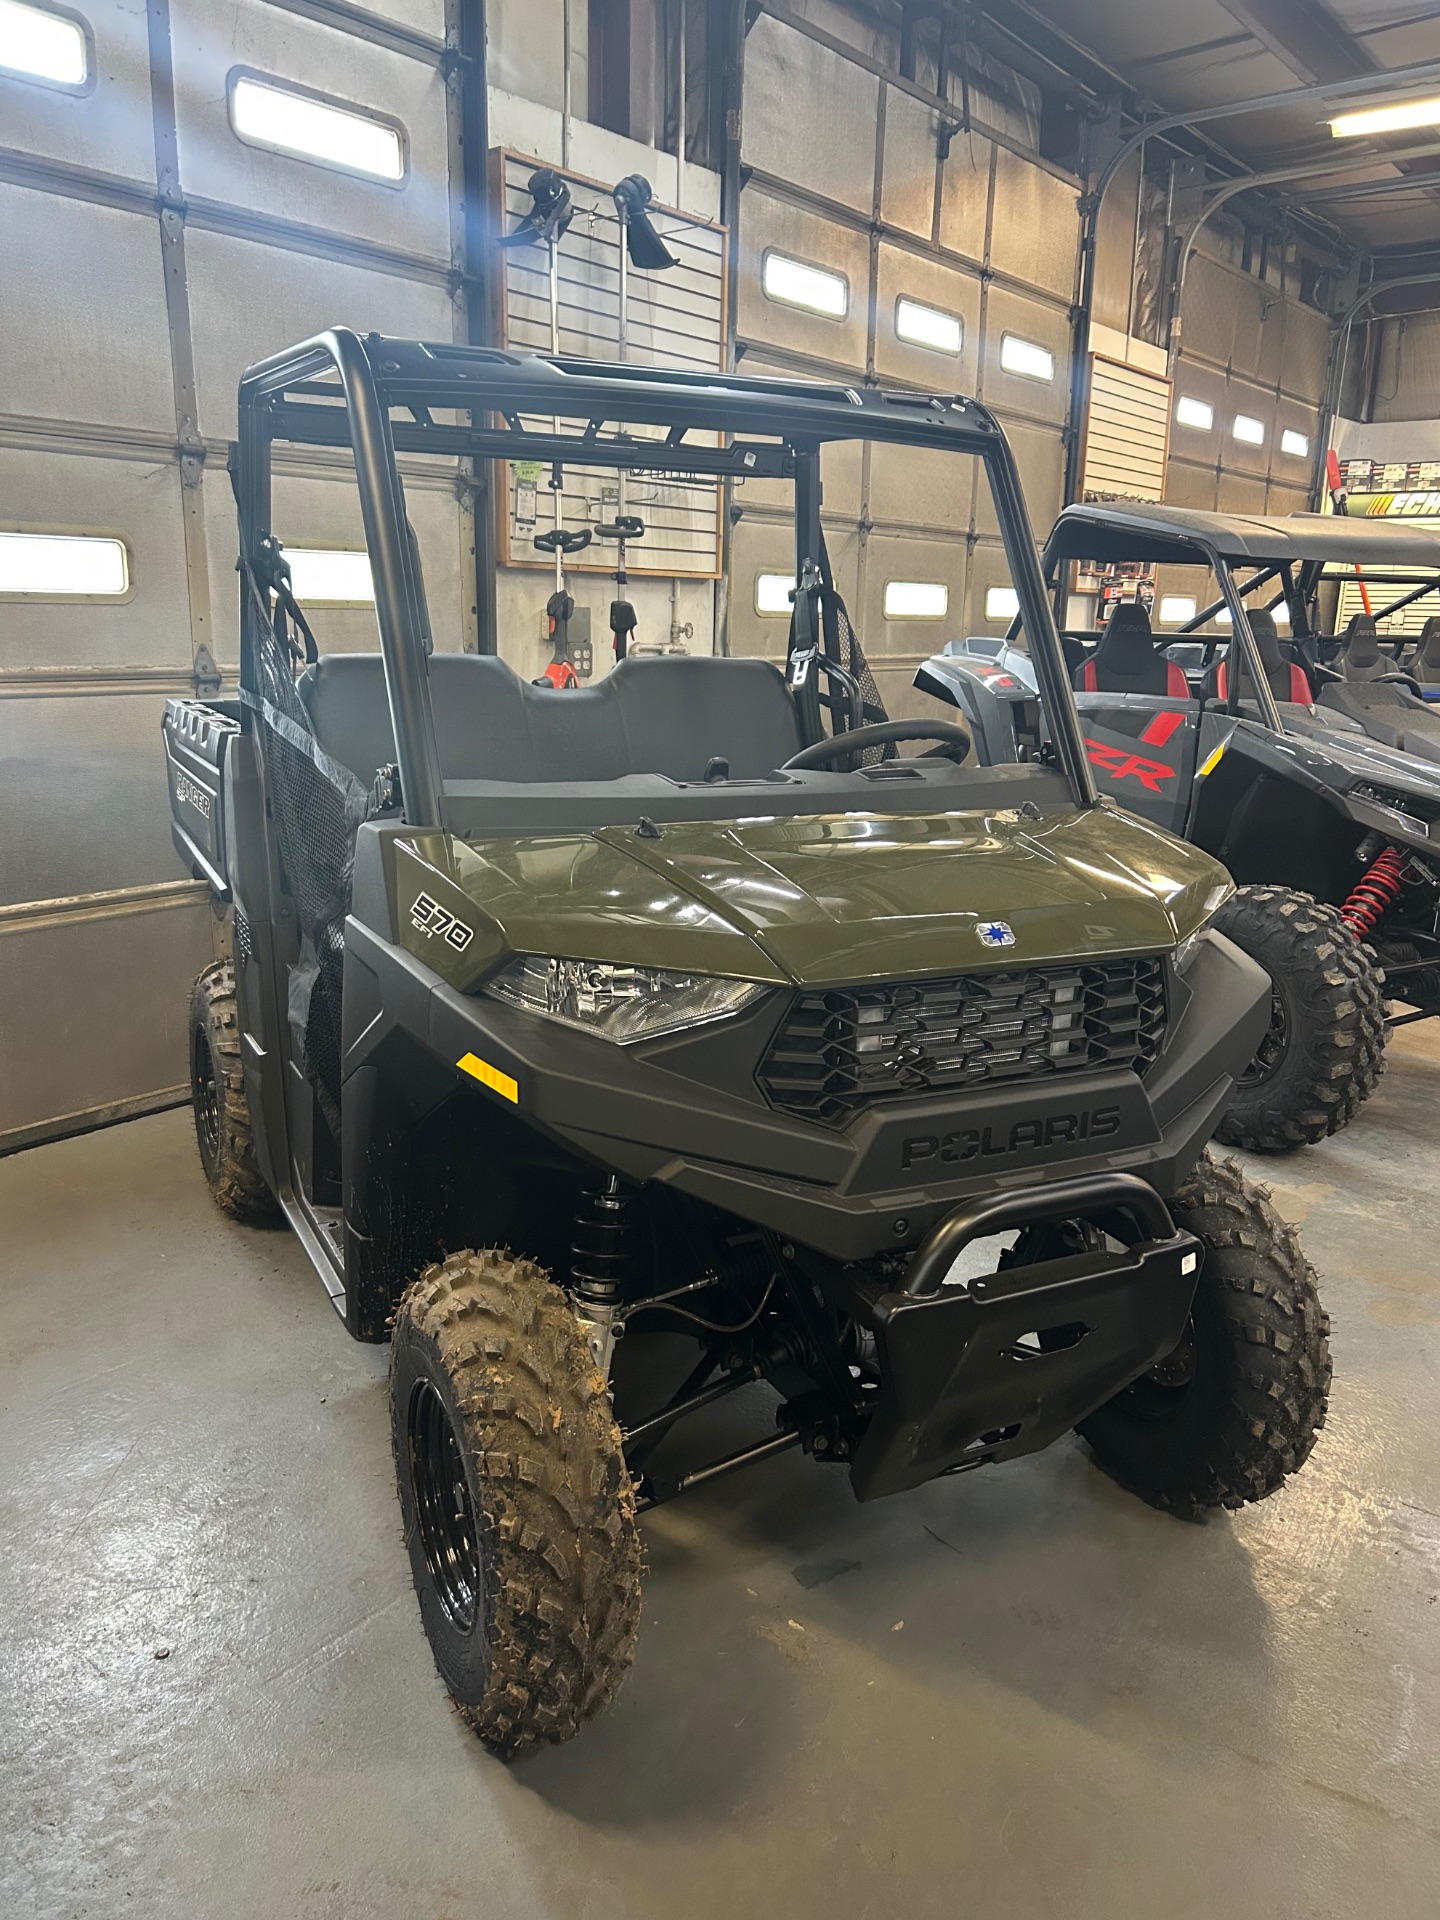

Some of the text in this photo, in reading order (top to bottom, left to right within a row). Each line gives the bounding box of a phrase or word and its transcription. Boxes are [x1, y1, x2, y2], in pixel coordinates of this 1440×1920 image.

[1083, 738, 1177, 793] ZR
[176, 771, 211, 819] RANGER
[409, 891, 474, 952] 570
[411, 917, 433, 939] EFI
[901, 1105, 1121, 1171] POLARIS
